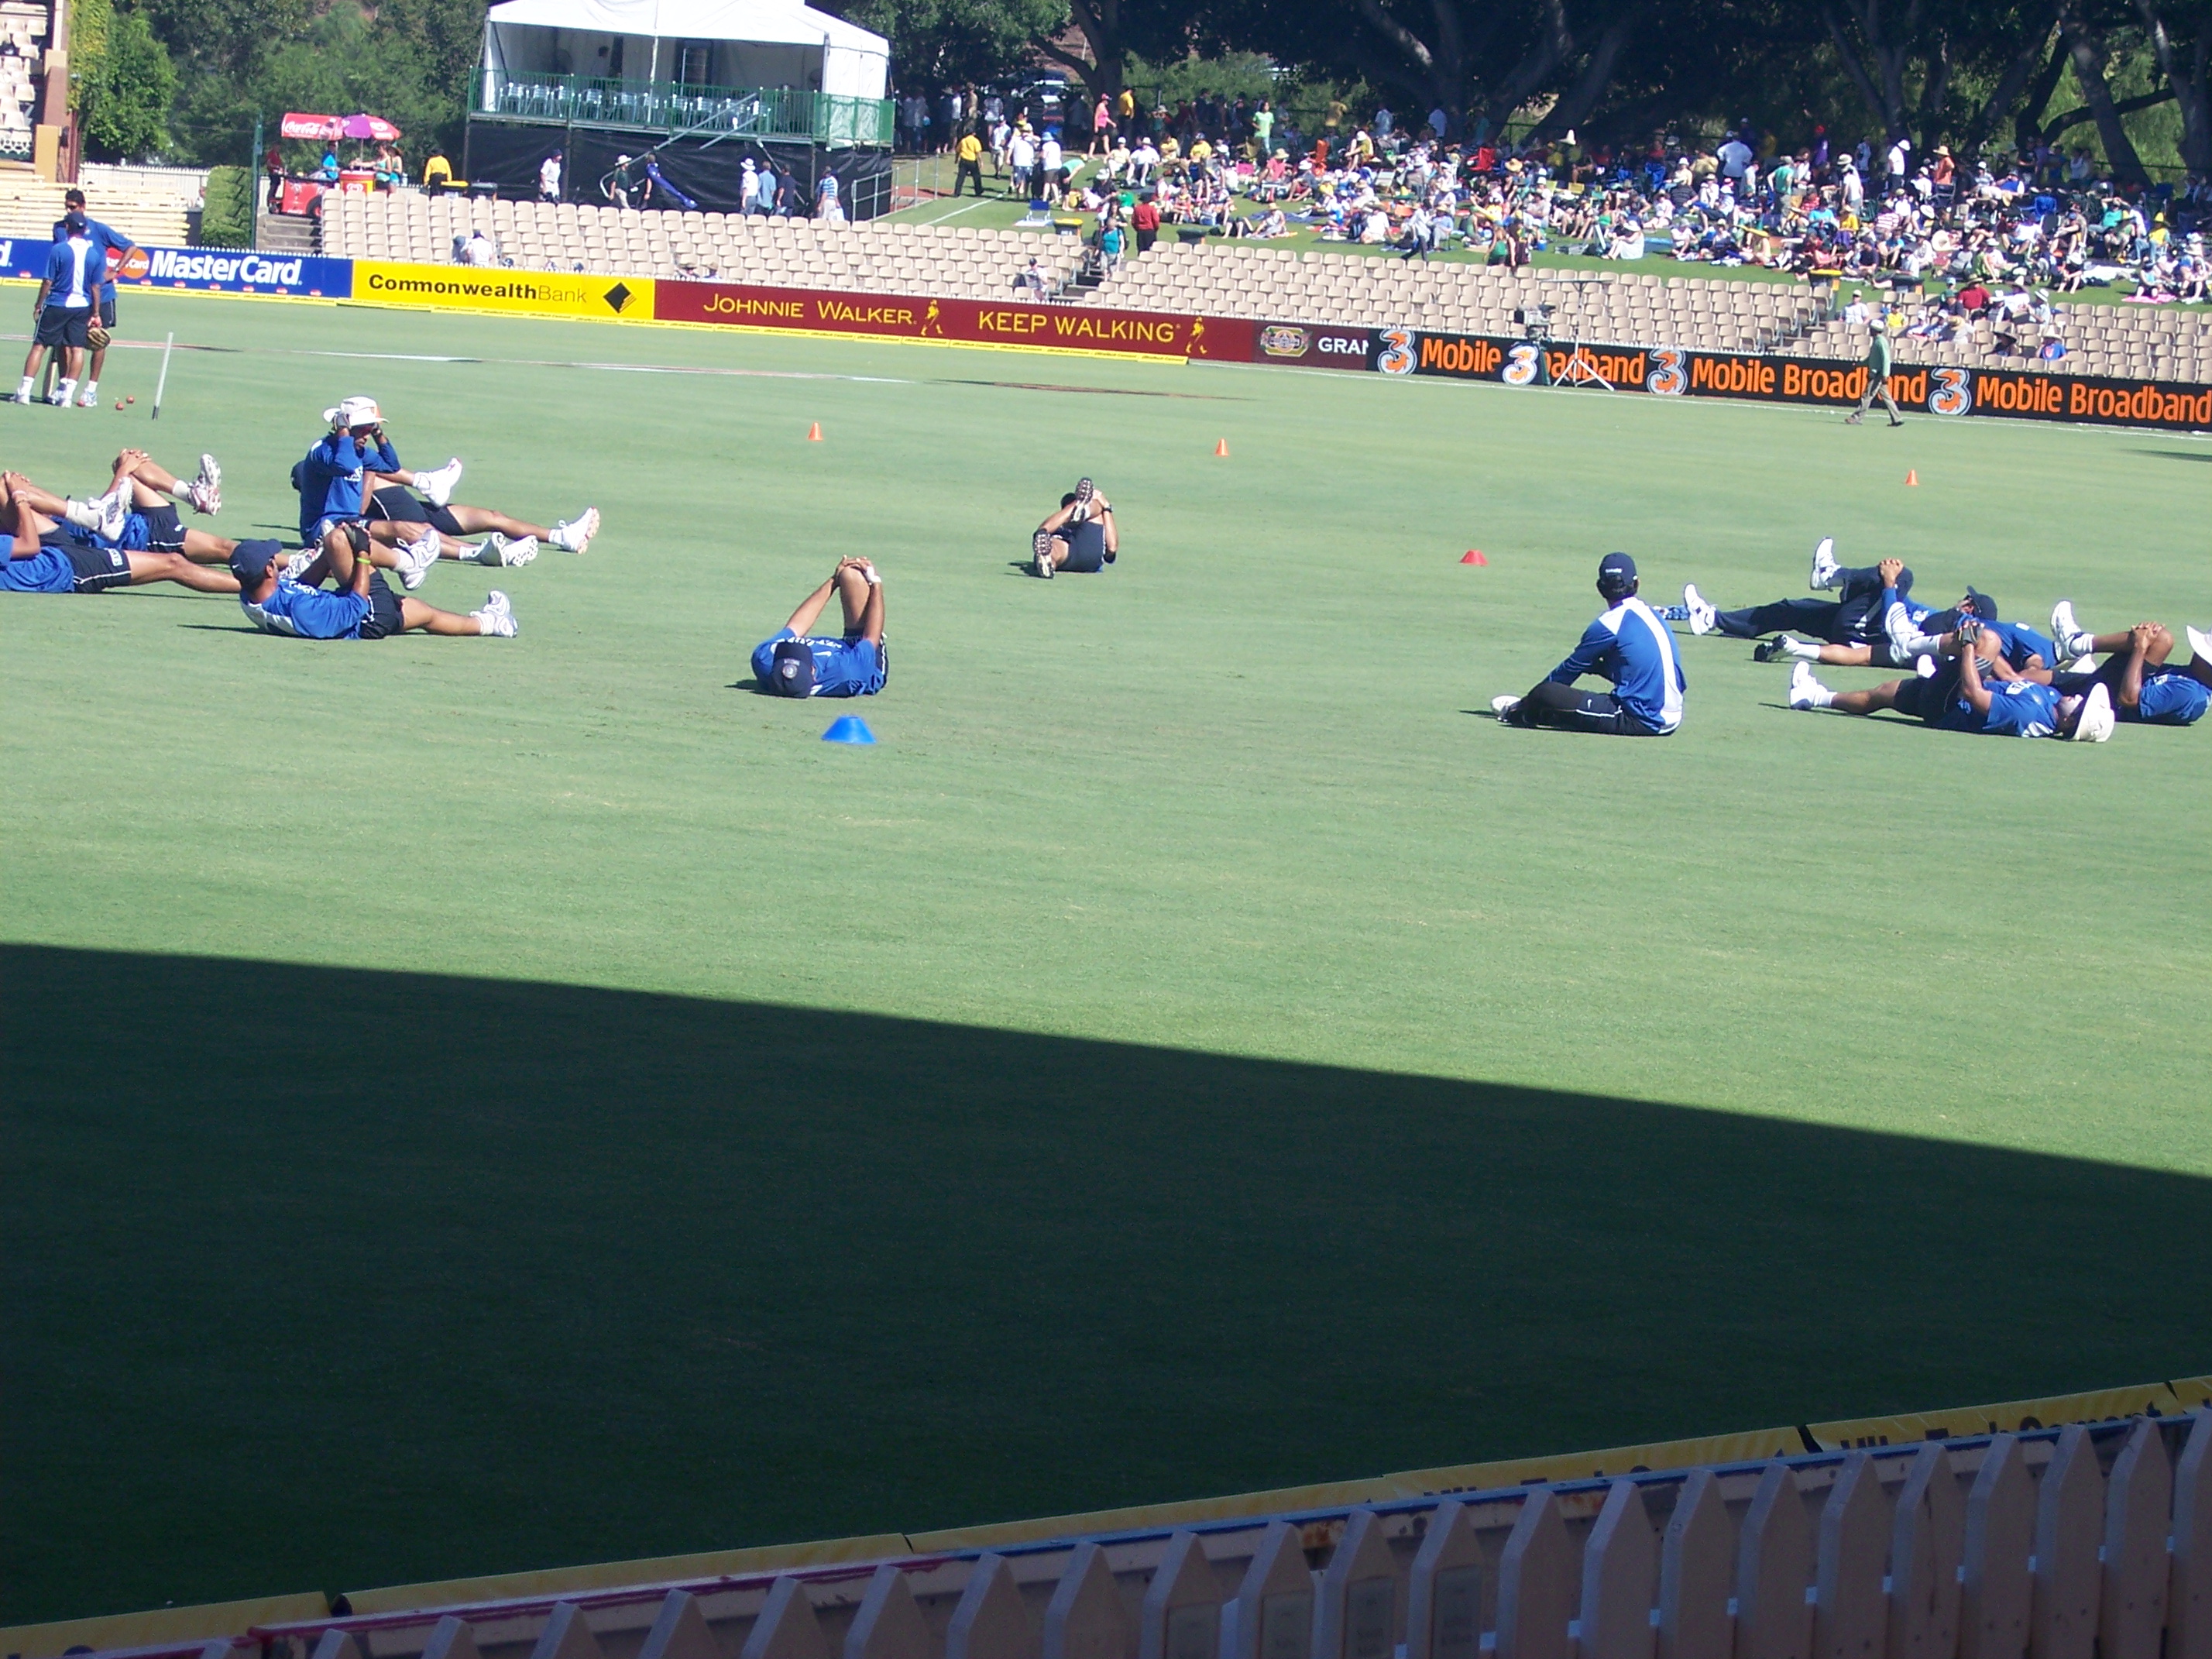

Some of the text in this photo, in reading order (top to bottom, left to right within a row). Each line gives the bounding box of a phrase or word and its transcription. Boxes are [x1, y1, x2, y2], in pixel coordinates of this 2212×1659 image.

[150, 249, 301, 284] MasterCard
[703, 293, 913, 325] JOHNNIE WALKER
[978, 311, 1174, 343] KEEP WALKING
[1378, 328, 1646, 385] 3 Mobile adband
[1647, 349, 1688, 396] 3
[1692, 358, 1776, 393] Mobile
[1929, 367, 2212, 424] 3 Mobile Broadband
